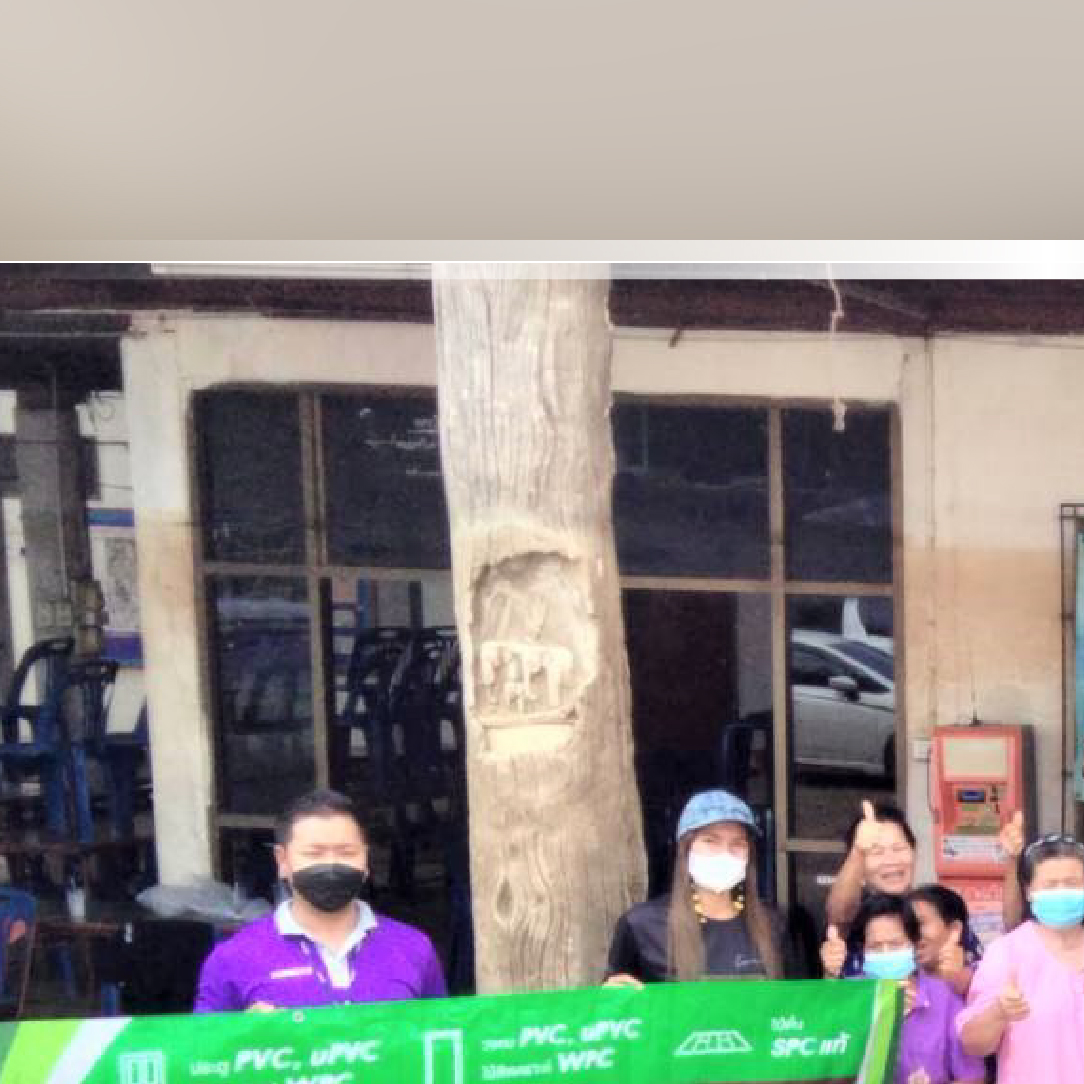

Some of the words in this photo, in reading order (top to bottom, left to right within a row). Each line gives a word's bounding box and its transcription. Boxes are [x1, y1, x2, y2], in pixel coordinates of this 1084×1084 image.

[580, 1017, 643, 1041] uPVC
[234, 1046, 301, 1072] PVC,
[310, 1039, 382, 1067] uPVC
[770, 1036, 817, 1057] SPC
[557, 1047, 615, 1074] WPC
